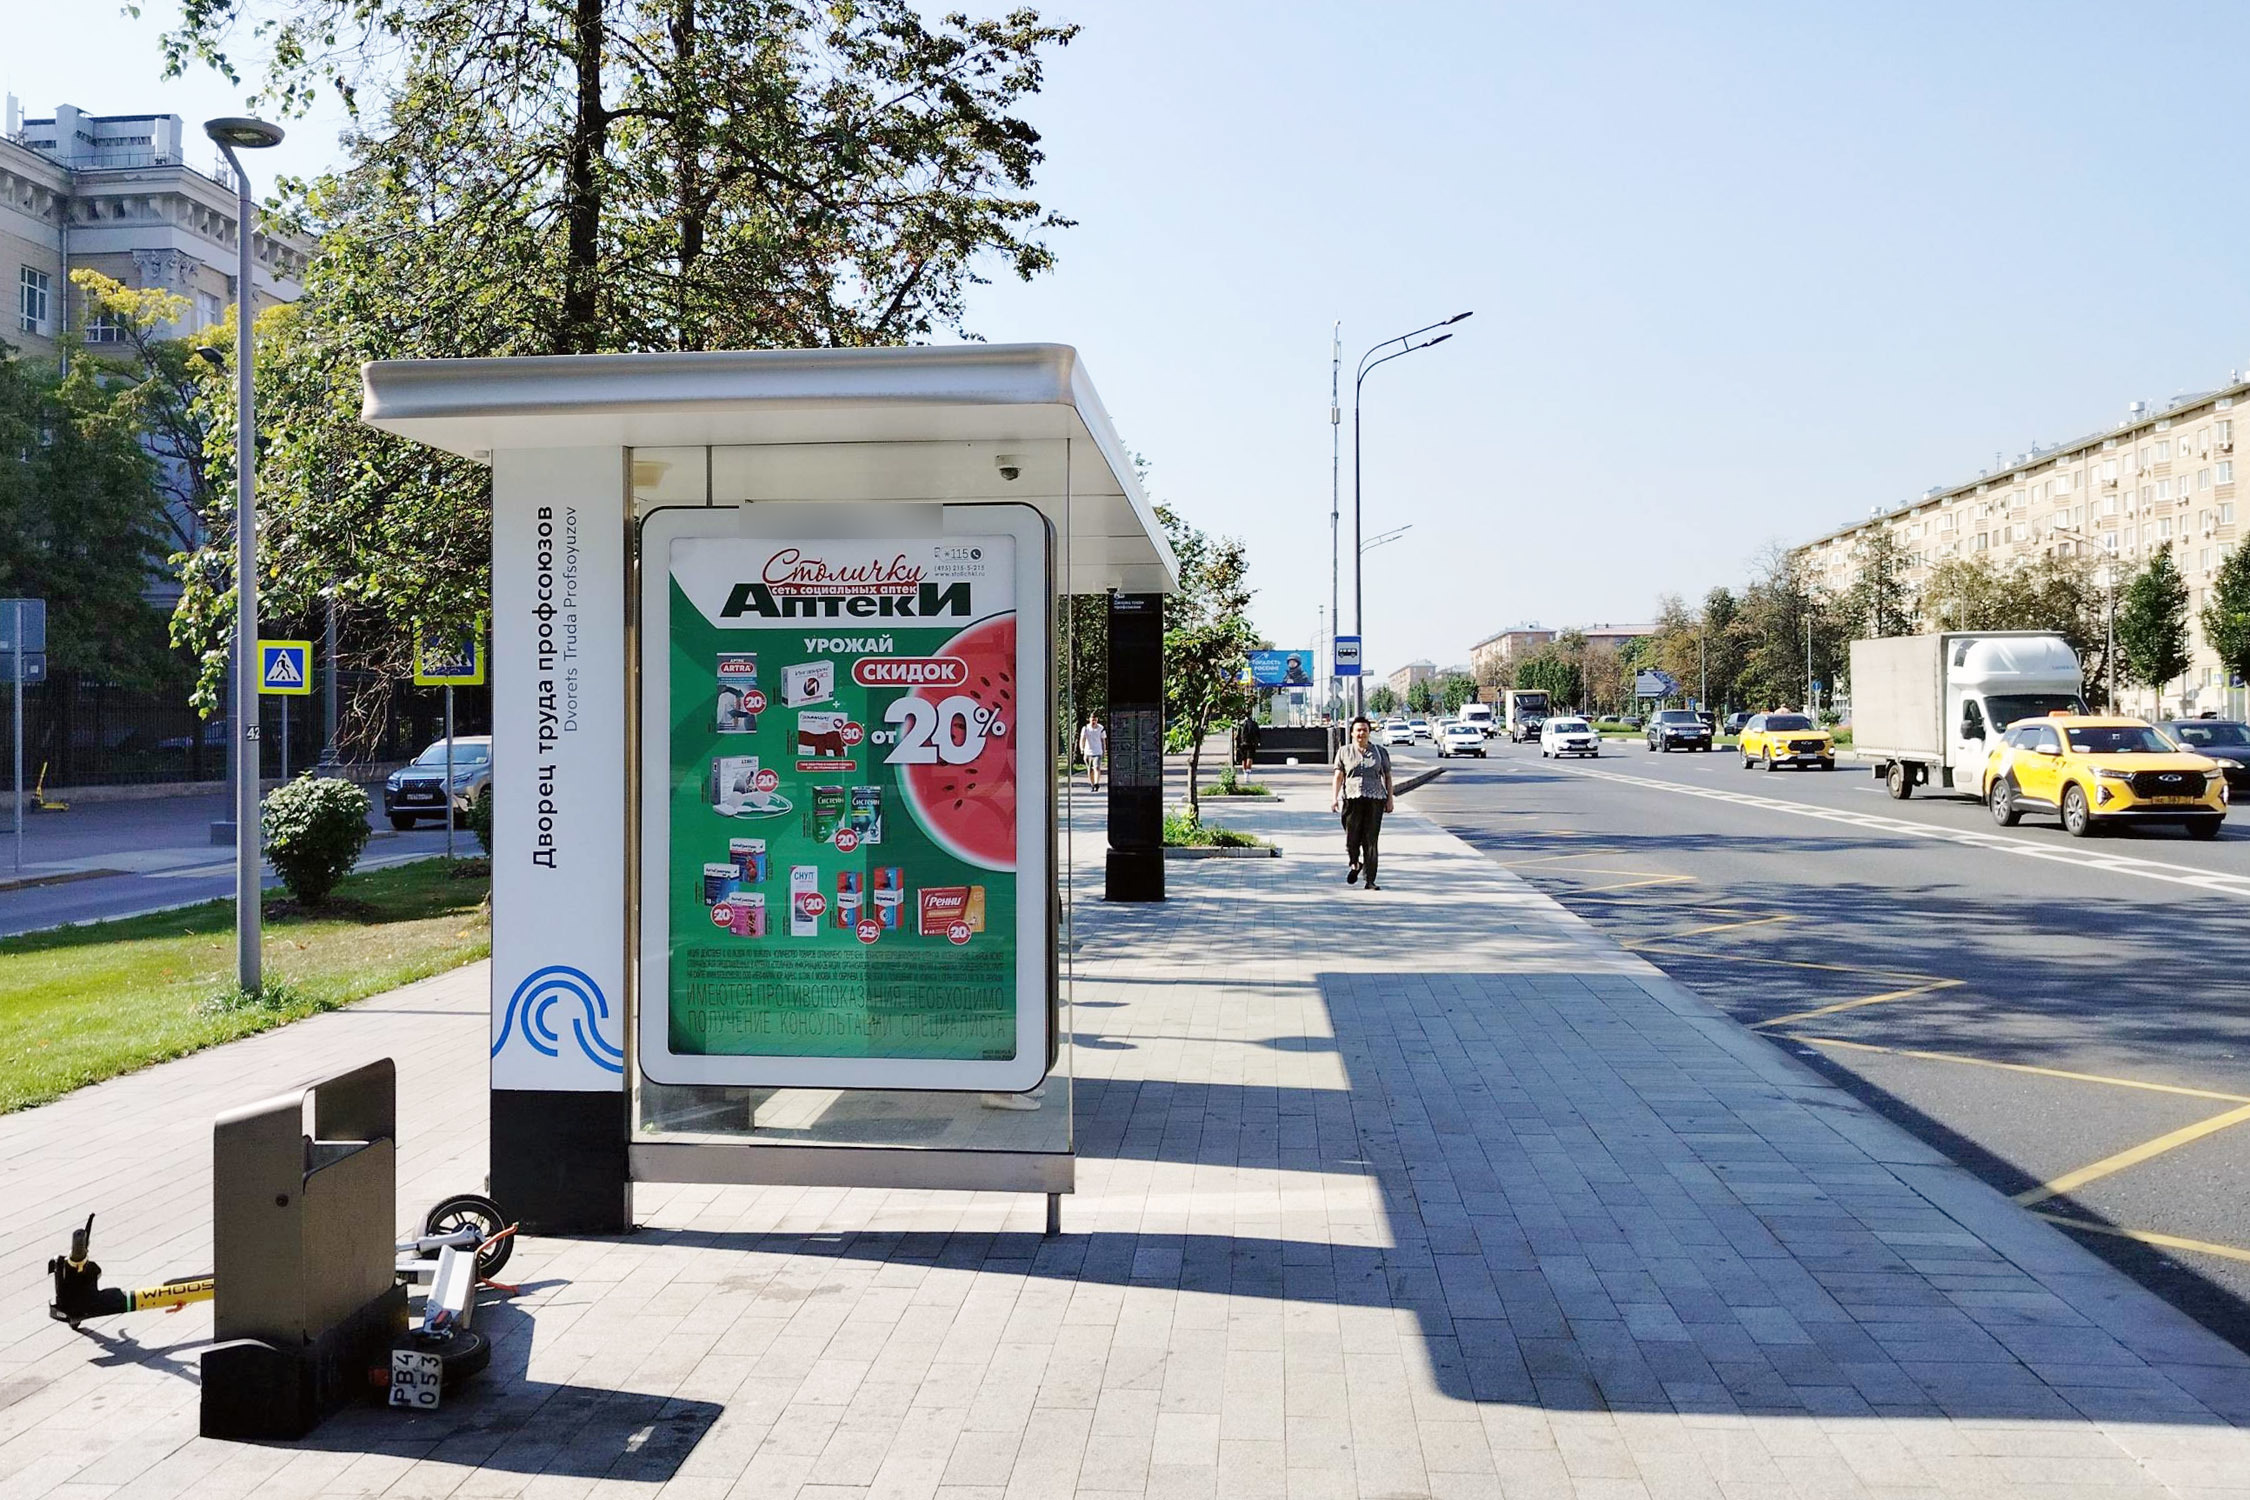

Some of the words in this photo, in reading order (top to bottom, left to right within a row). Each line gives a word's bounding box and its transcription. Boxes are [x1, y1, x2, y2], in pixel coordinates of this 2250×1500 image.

[562, 506, 580, 608] Profsoyuzov
[762, 548, 928, 584] Столички
[532, 506, 558, 670] профсоюзов
[772, 586, 798, 596] сеть
[800, 585, 876, 597] социальных
[880, 585, 917, 595] аптек
[563, 614, 577, 661] Truda
[803, 633, 893, 653] УРОЖАЙ
[723, 664, 752, 672] ARTRA
[863, 663, 956, 682] СКИДОК
[538, 680, 558, 754] труда
[564, 667, 577, 731] Dvorets
[883, 695, 1006, 765] 20%
[533, 764, 558, 869] Дворец
[794, 871, 815, 880] СНУП
[687, 983, 752, 1006] ИМЕЮТСЯ
[908, 986, 1004, 1011] НЕОБХОДИМО
[687, 1010, 771, 1034] ПОЛУЧЕНИЕ
[780, 1011, 892, 1036] КОНСУЛЬТАЦИИ
[901, 1013, 1006, 1039] СПЕЦИАЛИСТА
[142, 1282, 215, 1299] WHOOS
[418, 1356, 439, 1405] 053
